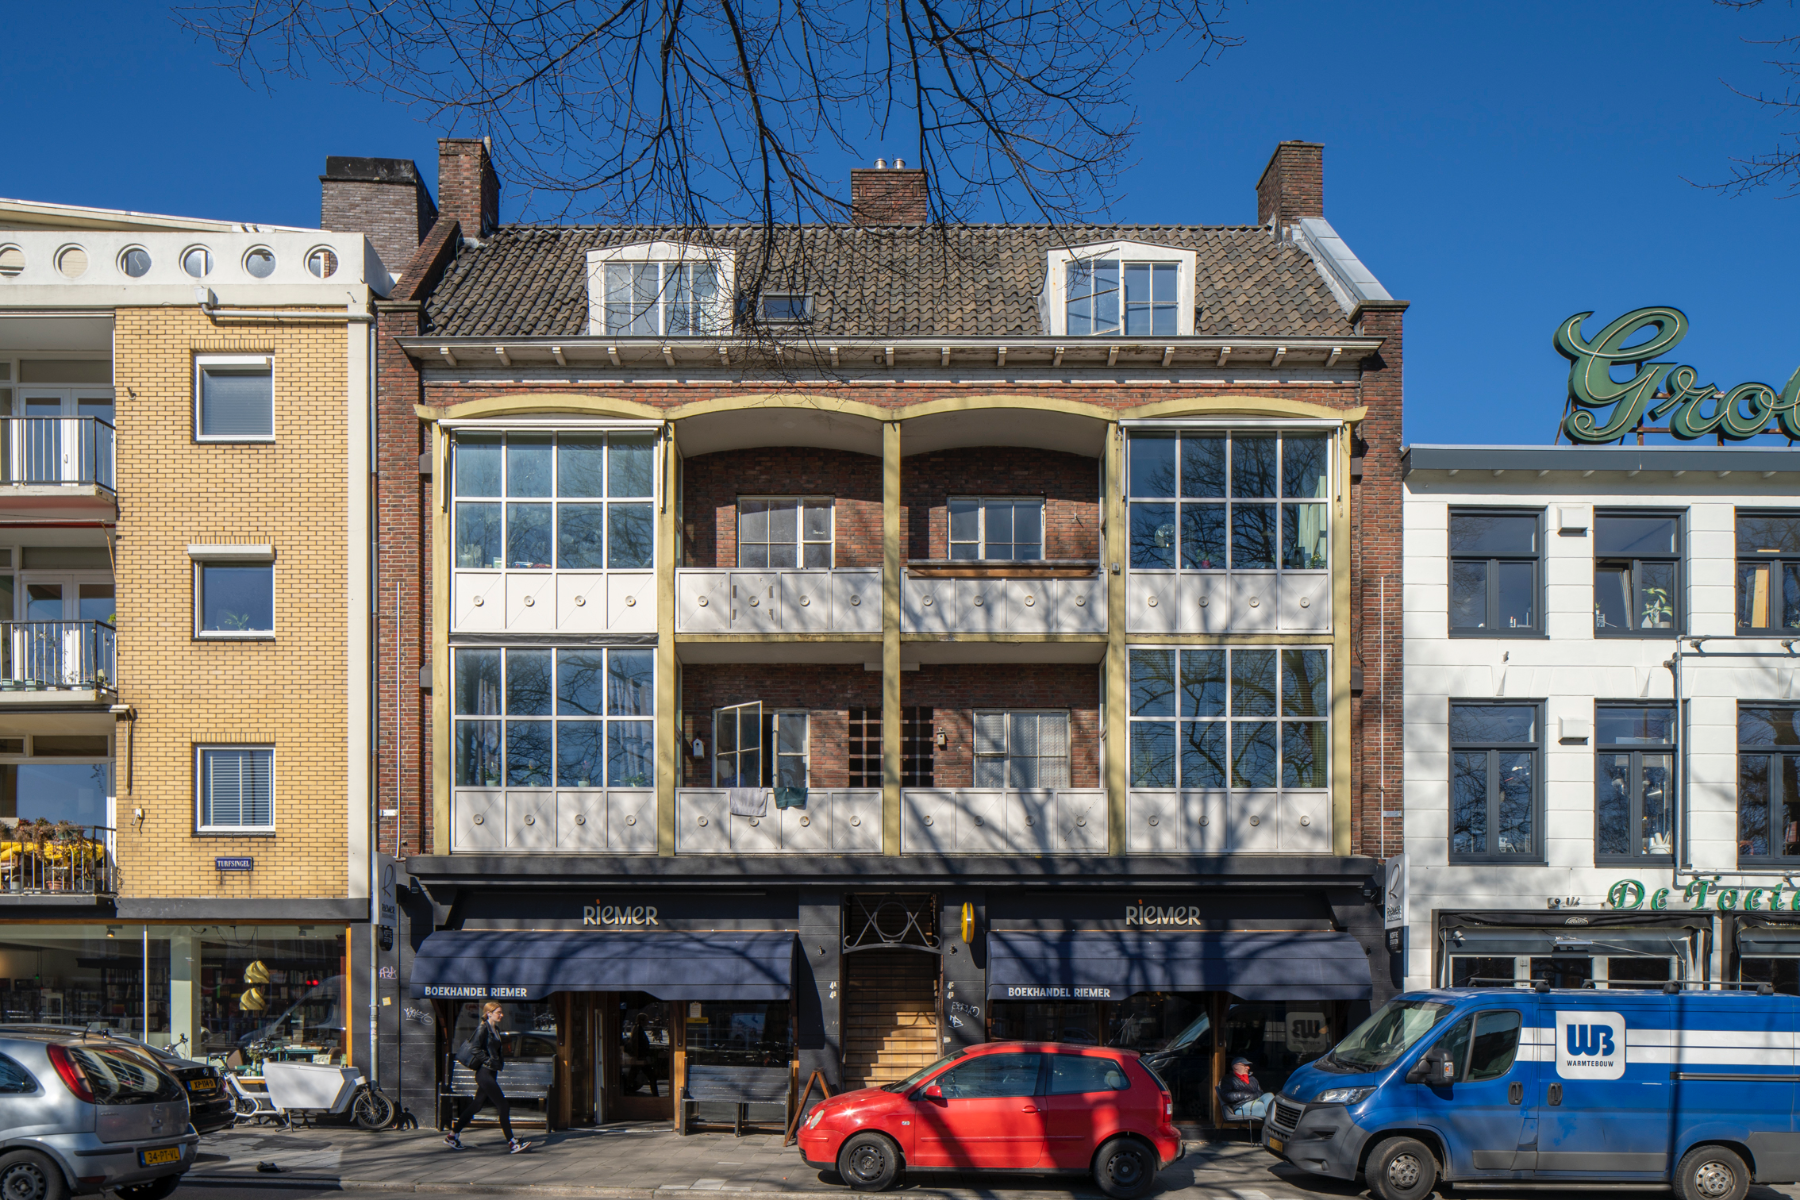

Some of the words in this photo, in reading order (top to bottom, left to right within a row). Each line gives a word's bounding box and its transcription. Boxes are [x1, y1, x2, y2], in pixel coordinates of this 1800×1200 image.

[217, 860, 250, 868] TURFSINGEL
[1608, 879, 1669, 911] De
[424, 986, 488, 997] BOEKHANDEL
[490, 987, 528, 998] RIEMER
[1008, 987, 1071, 998] BOEKHANDEL
[1073, 988, 1111, 998] RIEMER
[1566, 1024, 1615, 1056] WB
[147, 1149, 178, 1163] 34-PT-VL
